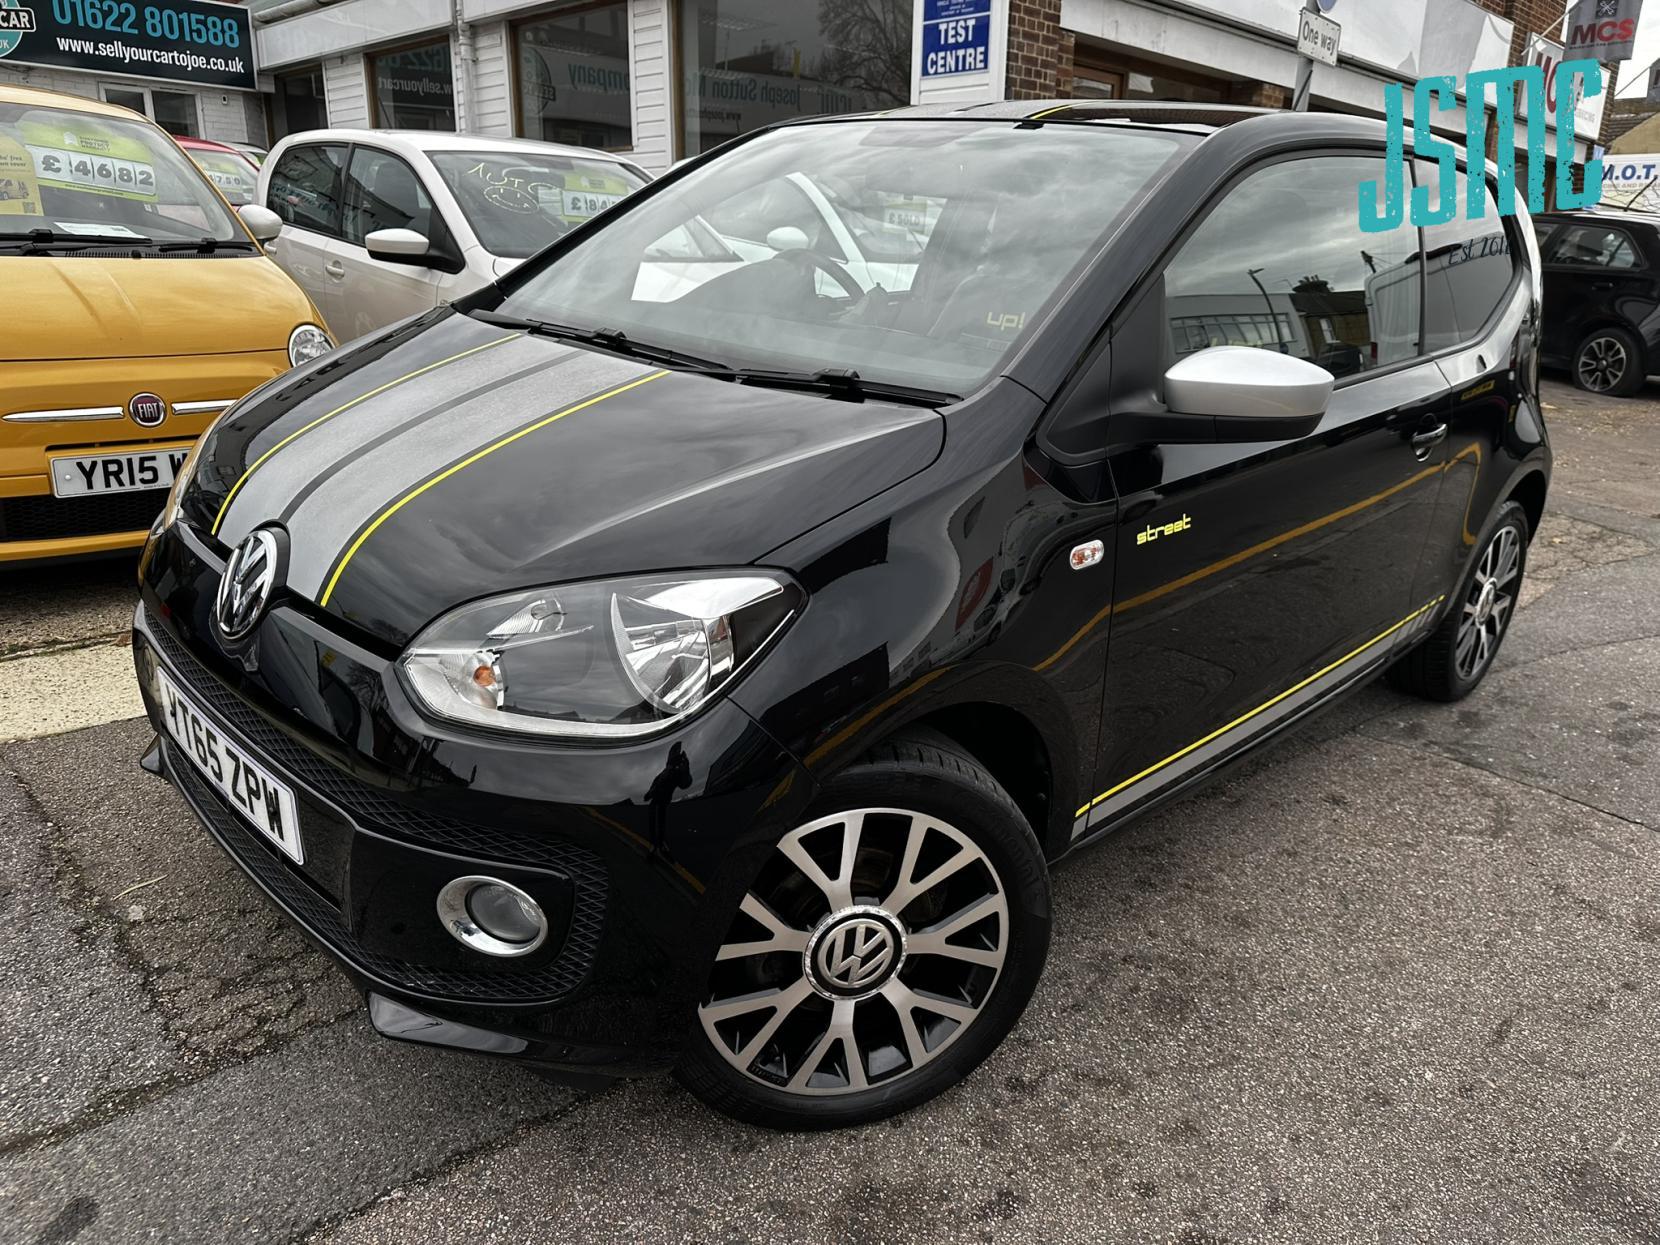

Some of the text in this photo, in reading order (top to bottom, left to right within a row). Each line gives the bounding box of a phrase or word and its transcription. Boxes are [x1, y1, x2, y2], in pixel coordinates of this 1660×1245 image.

[52, 0, 241, 48] 01622 801588
[938, 19, 976, 45] TEST
[1302, 20, 1337, 56] One way
[1570, 18, 1634, 46] MCS
[56, 37, 244, 73] www.sellyourcartojoe.co.uk
[927, 46, 985, 74] CENTRE
[986, 311, 1026, 331] up!
[137, 402, 159, 419] FIAT
[76, 456, 159, 490] YR15
[1136, 513, 1192, 545] street
[165, 683, 285, 842] YT65 ZPW
